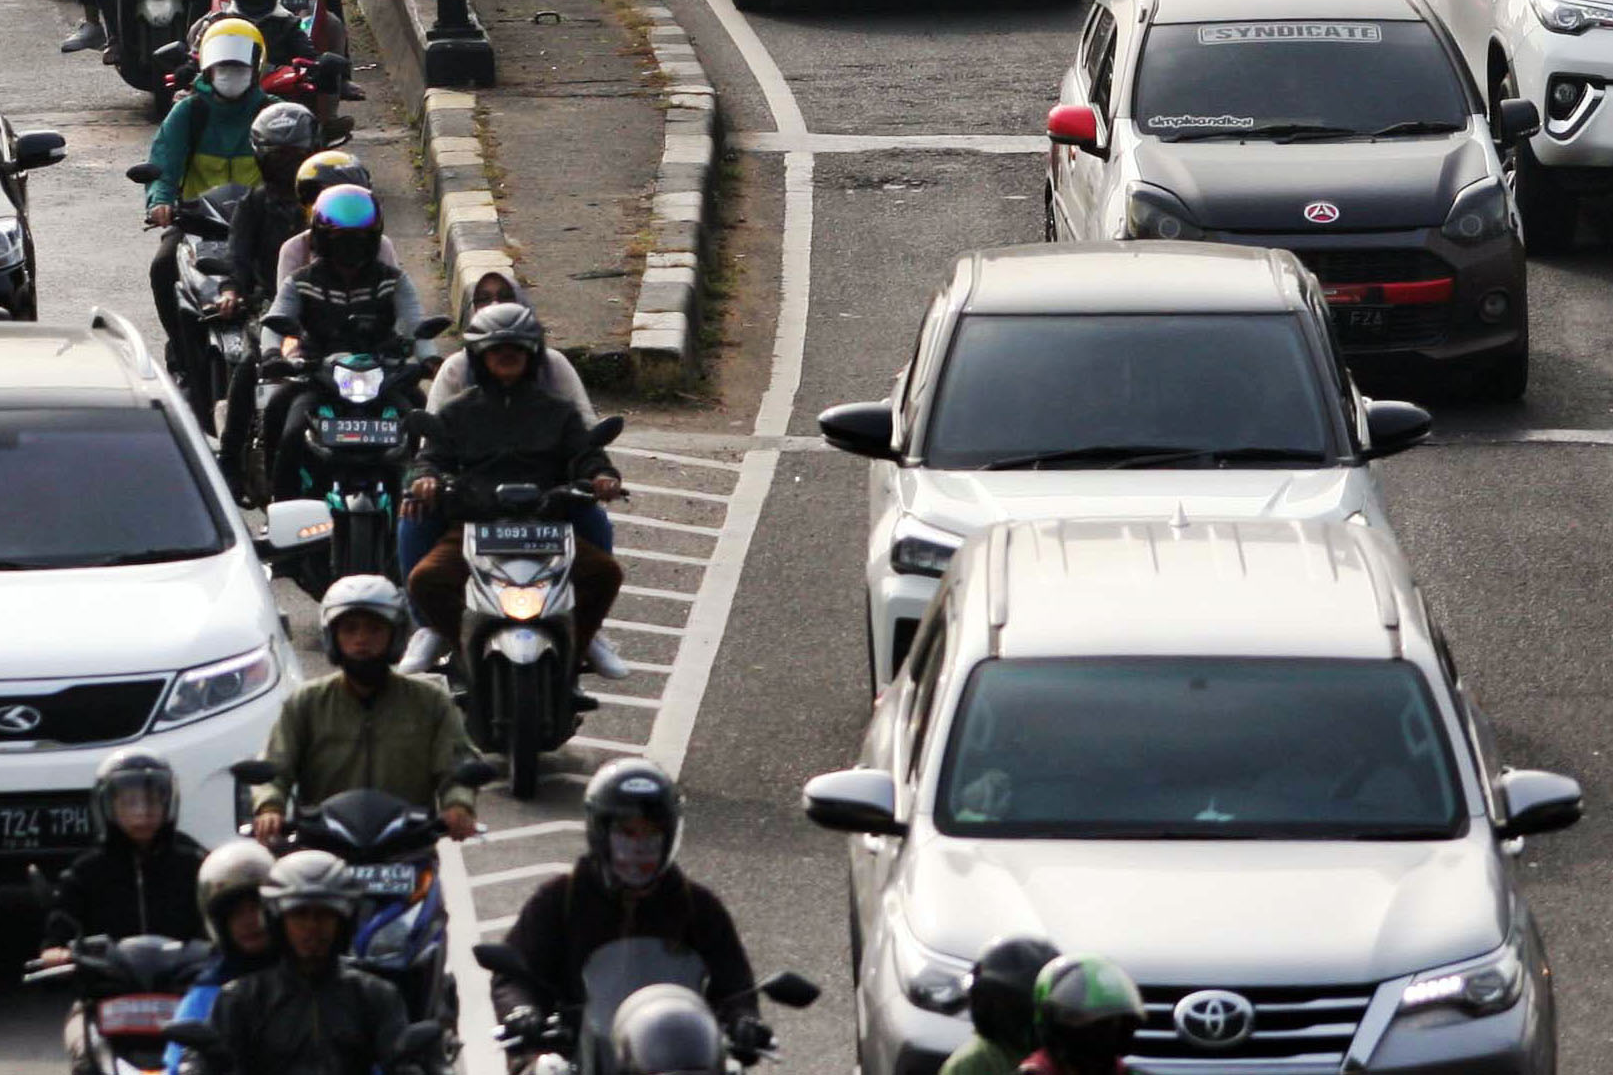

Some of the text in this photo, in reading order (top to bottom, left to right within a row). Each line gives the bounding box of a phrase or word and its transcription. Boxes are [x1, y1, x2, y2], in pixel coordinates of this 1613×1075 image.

[1216, 25, 1377, 41] SYNDICATE
[321, 420, 329, 431] B
[481, 527, 489, 538] B
[50, 806, 89, 835] TPH
